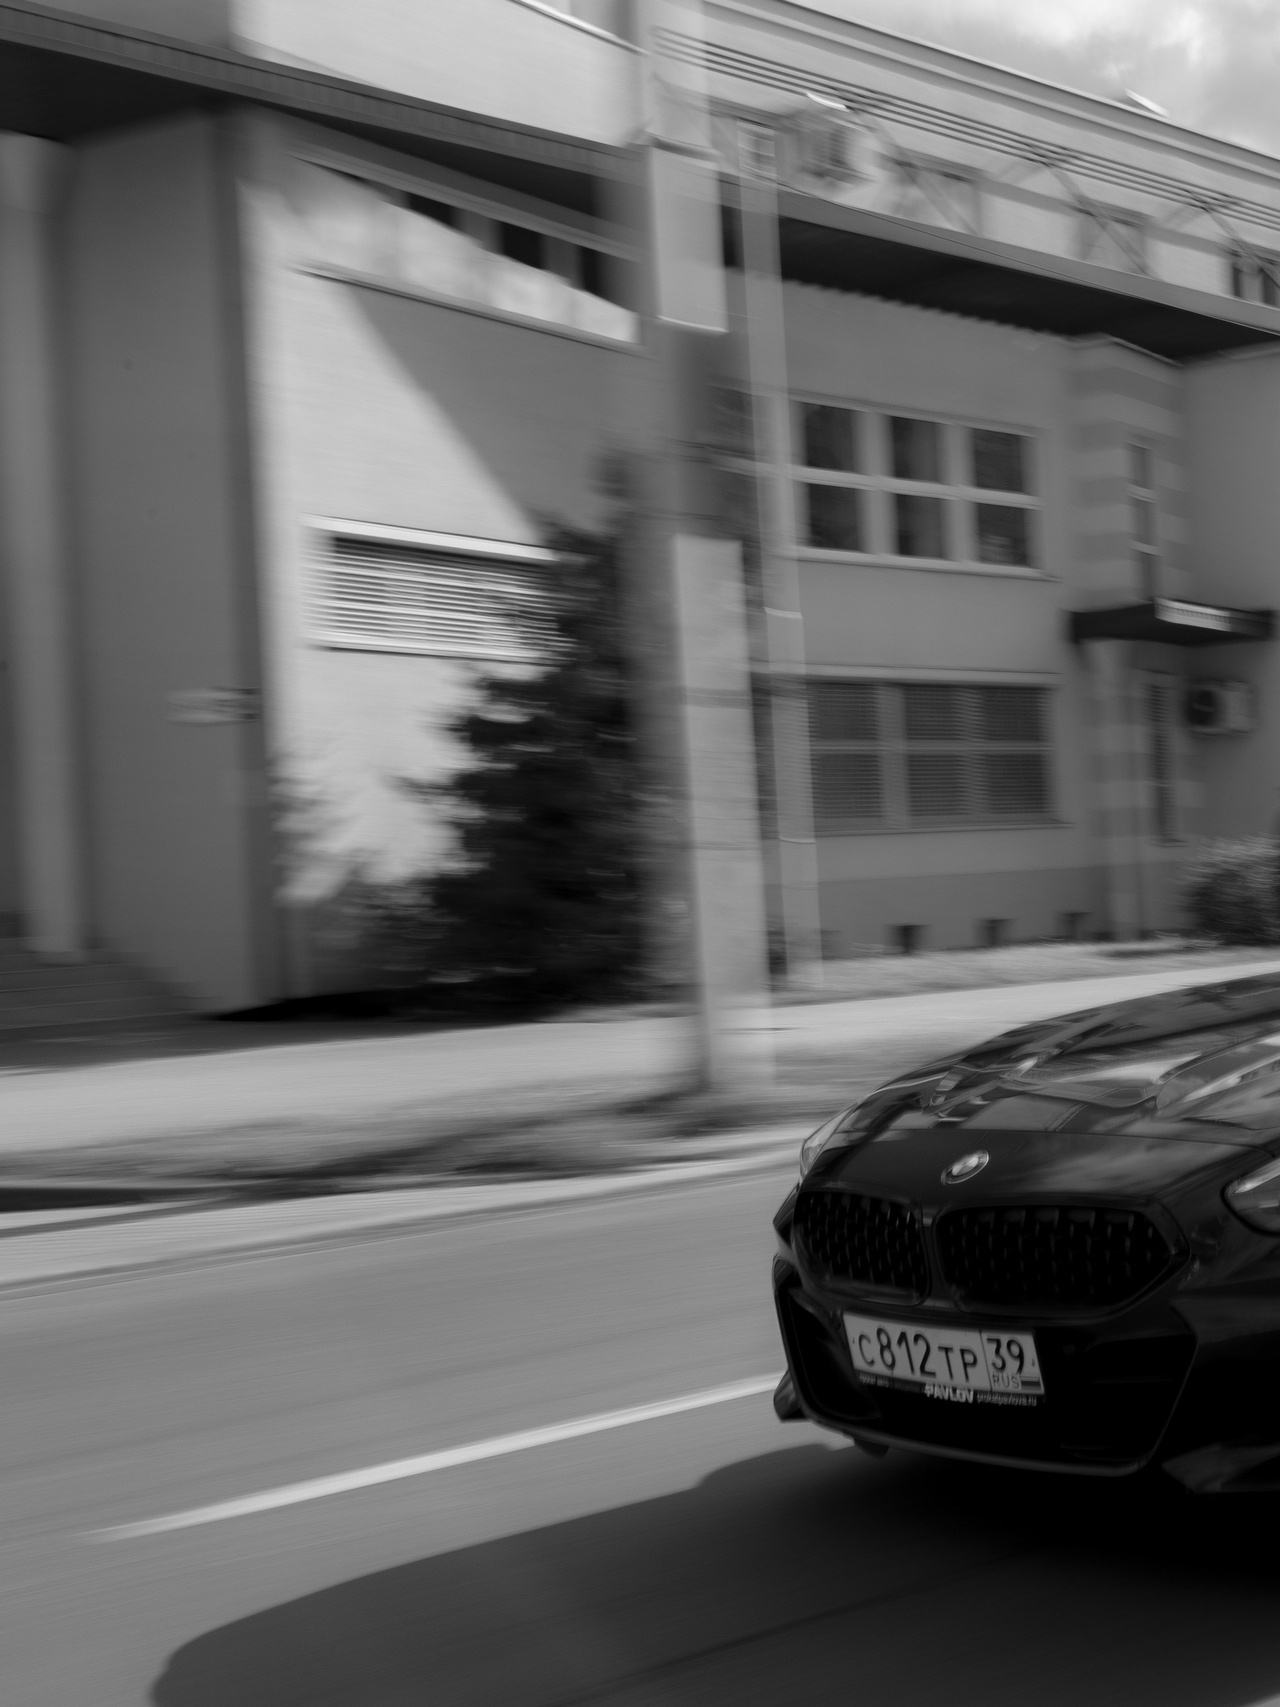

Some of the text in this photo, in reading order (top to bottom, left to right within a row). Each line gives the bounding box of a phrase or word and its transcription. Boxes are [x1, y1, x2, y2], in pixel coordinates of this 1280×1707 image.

[858, 1327, 1025, 1383] С812ТР 39
[992, 1373, 1020, 1389] RUS
